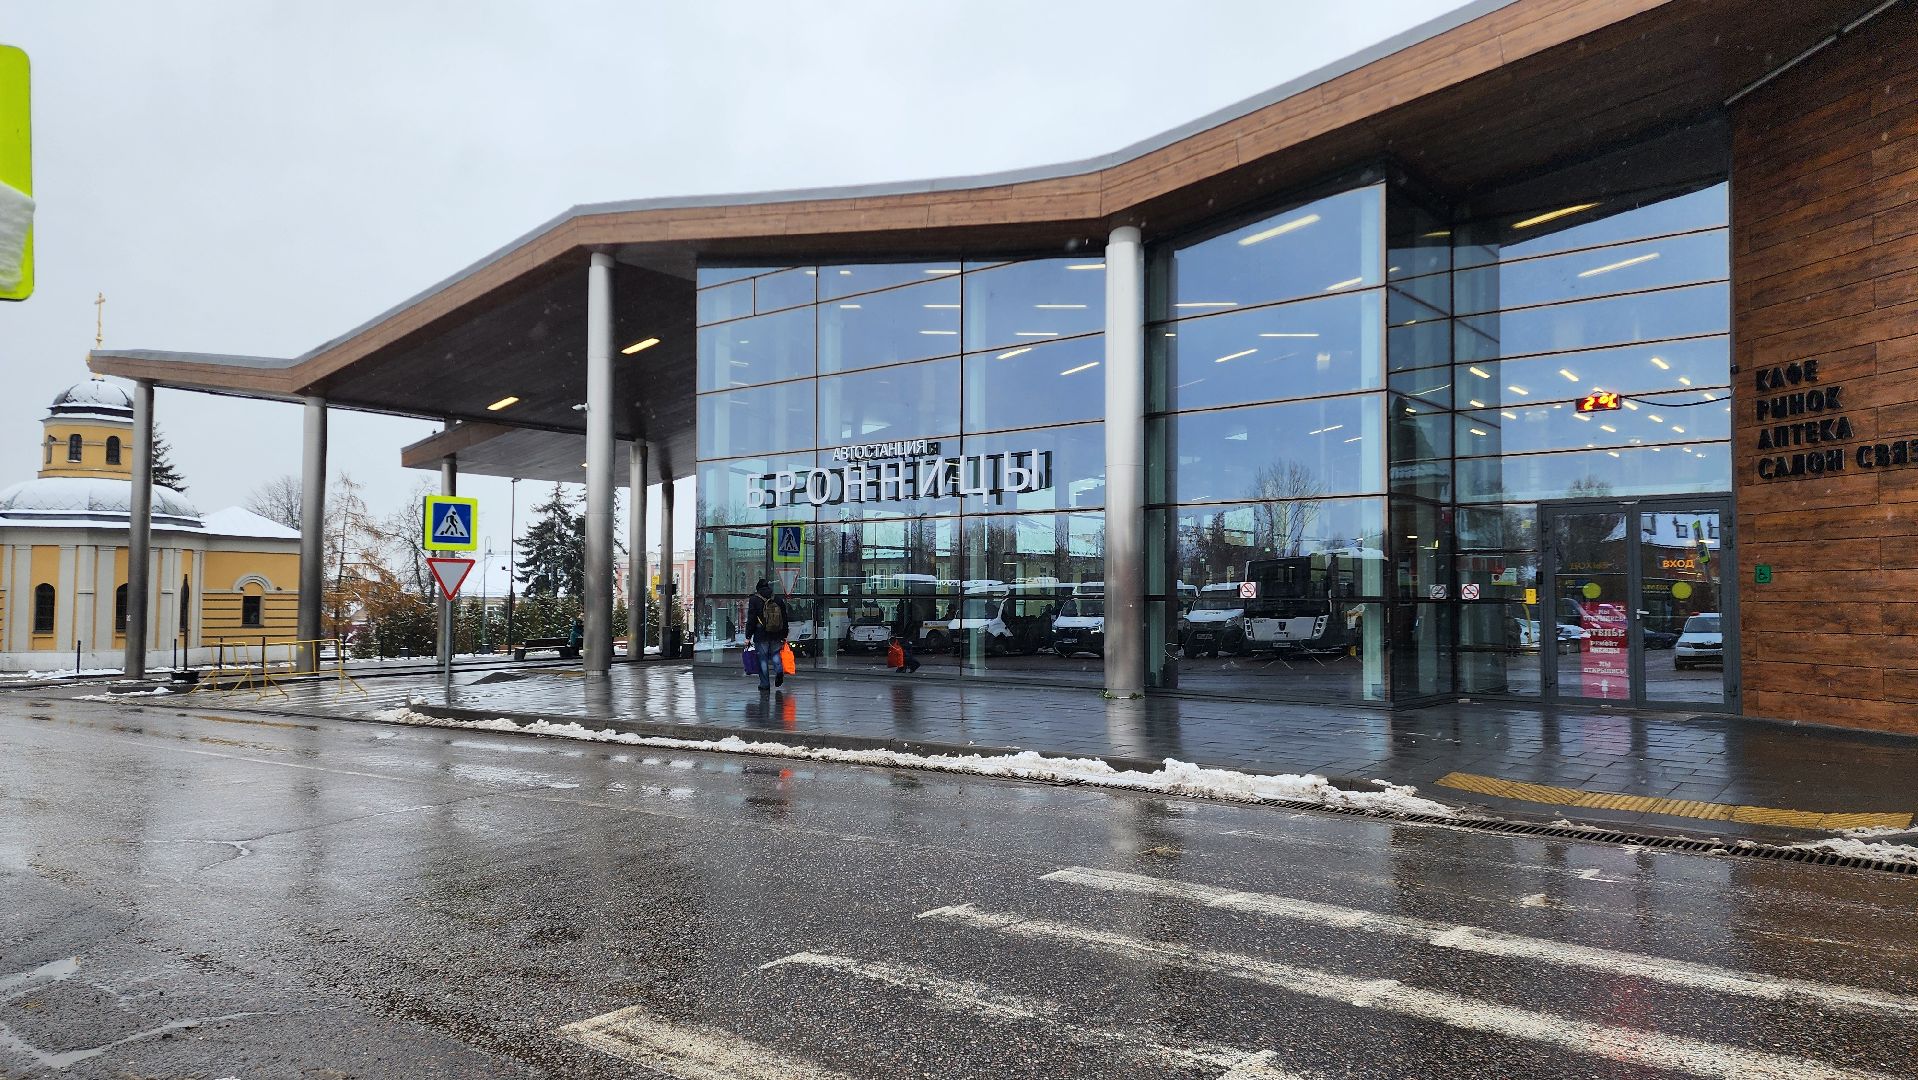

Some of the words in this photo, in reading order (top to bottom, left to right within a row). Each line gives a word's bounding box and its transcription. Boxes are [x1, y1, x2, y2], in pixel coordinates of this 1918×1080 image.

[1756, 360, 1819, 391] КАФЕ
[1756, 386, 1843, 421] РЫНОК
[1758, 416, 1854, 450] АПТЕКА
[832, 439, 928, 462] АВТОСТАНЦИЯ
[1758, 448, 1845, 480] САЛОН
[746, 448, 1039, 509] БРОННИЦЫ
[1662, 559, 1695, 569] ВХОД
